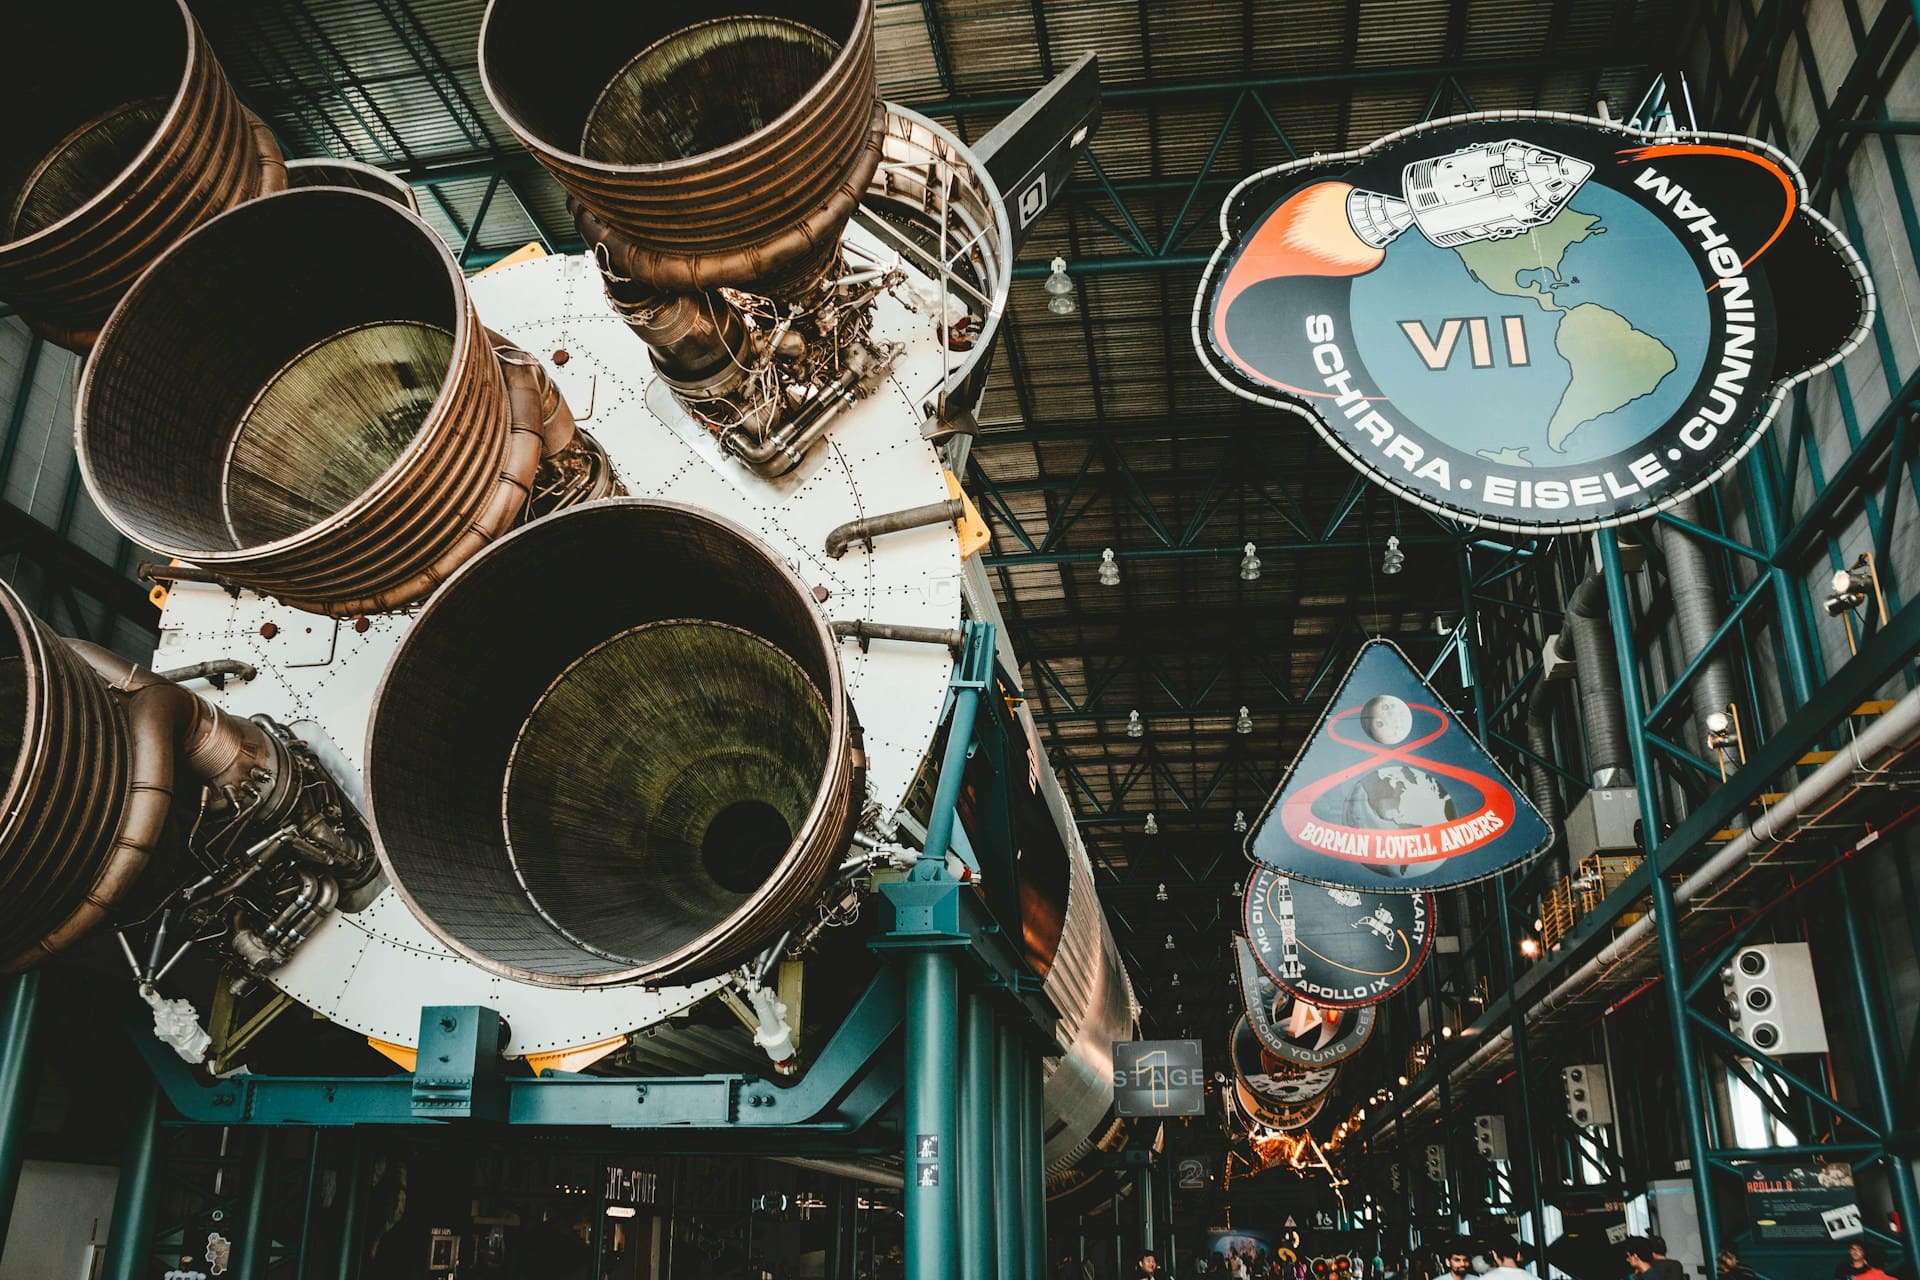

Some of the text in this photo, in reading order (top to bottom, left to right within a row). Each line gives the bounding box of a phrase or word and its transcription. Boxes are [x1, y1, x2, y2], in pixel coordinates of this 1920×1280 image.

[1305, 166, 1757, 508] SCHIRRA EISELE CUNNINGHAM
[1396, 315, 1531, 371] VII
[1298, 809, 1505, 860] BORMAN LOVELL ANDERS
[1295, 976, 1390, 1000] APOLLO IX
[1247, 976, 1282, 1050] STAFFORD
[1290, 1043, 1347, 1063] YOUNG
[1113, 1068, 1204, 1088] STAGE
[1136, 1050, 1169, 1108] 1
[1179, 1160, 1205, 1189] 2
[1746, 1180, 1783, 1193] APOLLO
